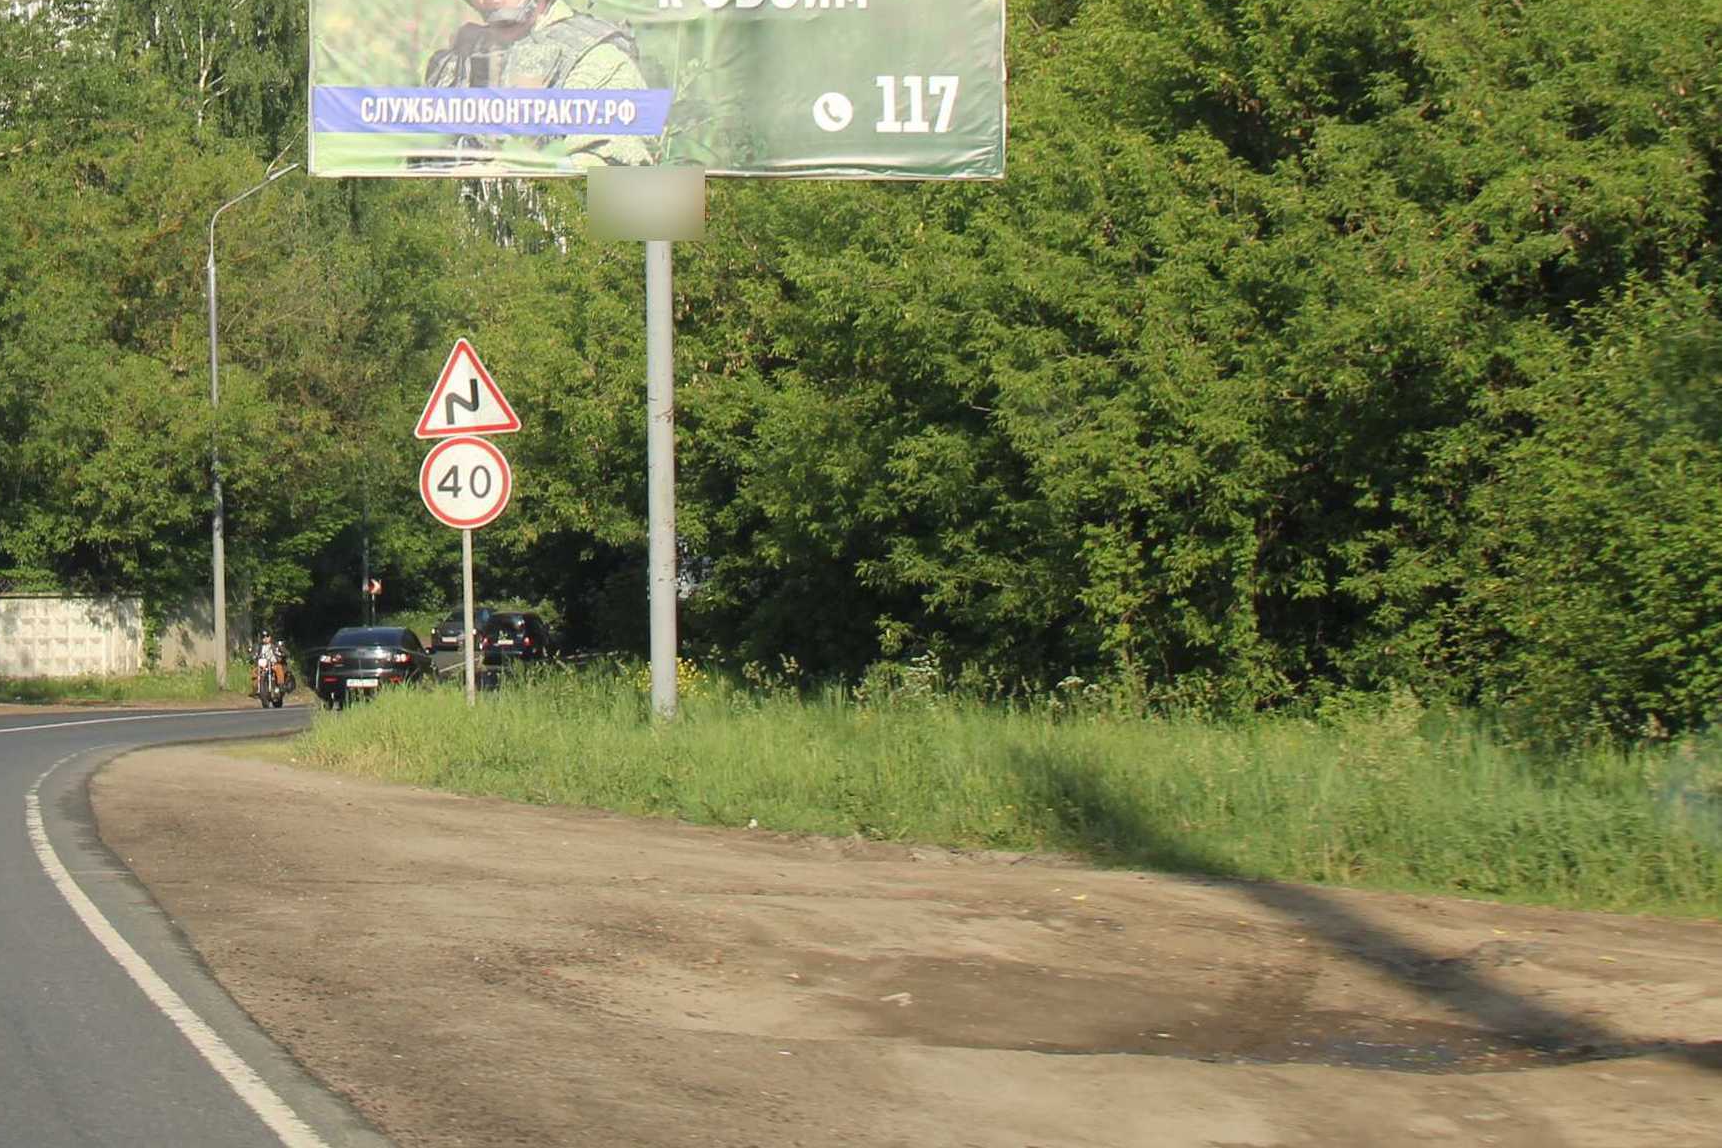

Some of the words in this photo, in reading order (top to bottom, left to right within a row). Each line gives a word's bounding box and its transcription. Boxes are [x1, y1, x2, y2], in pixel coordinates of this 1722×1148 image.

[360, 97, 637, 126] СЛУЖБАПОКОНТРАКТУ.РФ
[875, 75, 960, 133] 117
[436, 464, 492, 499] 40
